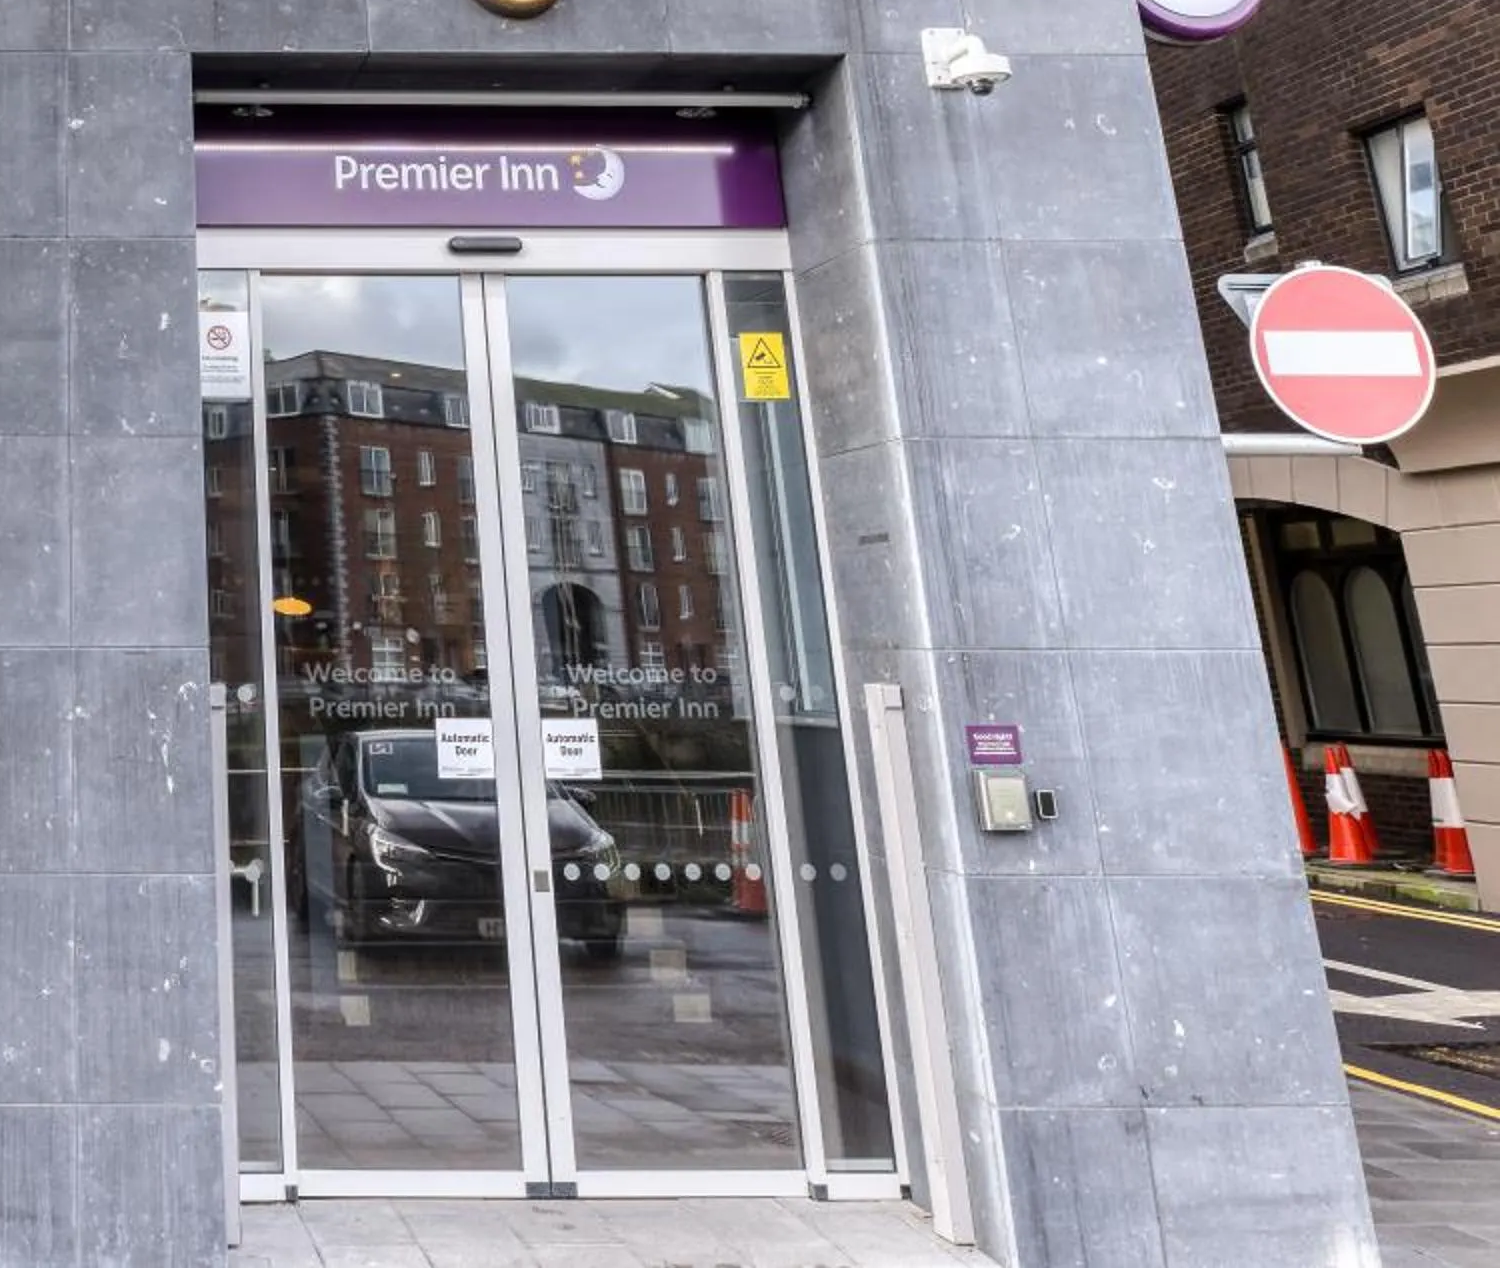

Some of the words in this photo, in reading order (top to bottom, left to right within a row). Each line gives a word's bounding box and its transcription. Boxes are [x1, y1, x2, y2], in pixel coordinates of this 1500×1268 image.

[334, 154, 489, 191] Premier
[499, 154, 560, 191] Inn
[304, 661, 424, 684] Welcome
[428, 663, 457, 684] to
[565, 663, 685, 685] Welcome
[690, 663, 718, 684] to
[308, 696, 410, 719] Premier
[416, 697, 456, 718] Inn
[572, 697, 673, 719] Premier
[679, 697, 720, 719] Inn
